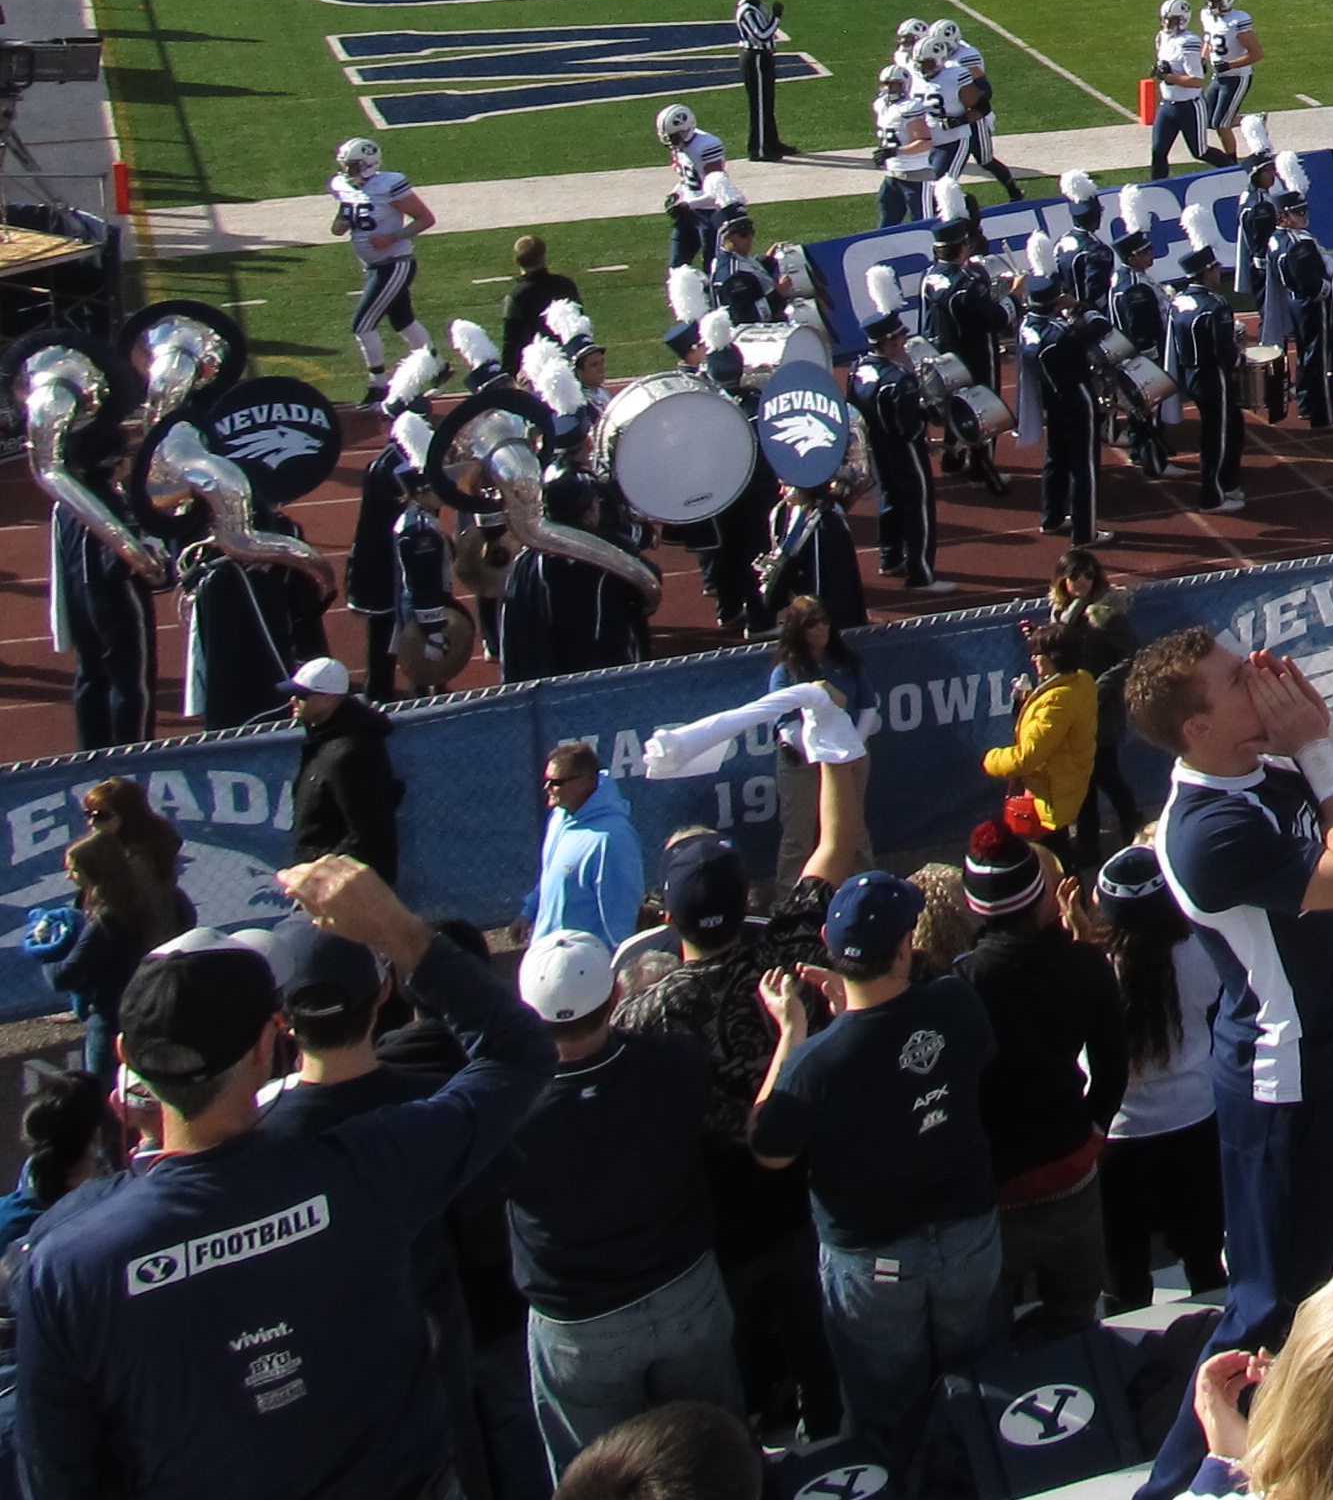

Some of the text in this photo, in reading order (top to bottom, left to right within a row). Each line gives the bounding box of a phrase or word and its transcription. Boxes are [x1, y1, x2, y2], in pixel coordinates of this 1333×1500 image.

[214, 403, 331, 437] NEVADA
[763, 389, 843, 424] NEVADA
[142, 1204, 323, 1283] Y FOOTBALL
[228, 1321, 294, 1351] vivint.
[251, 1350, 292, 1375] BYU
